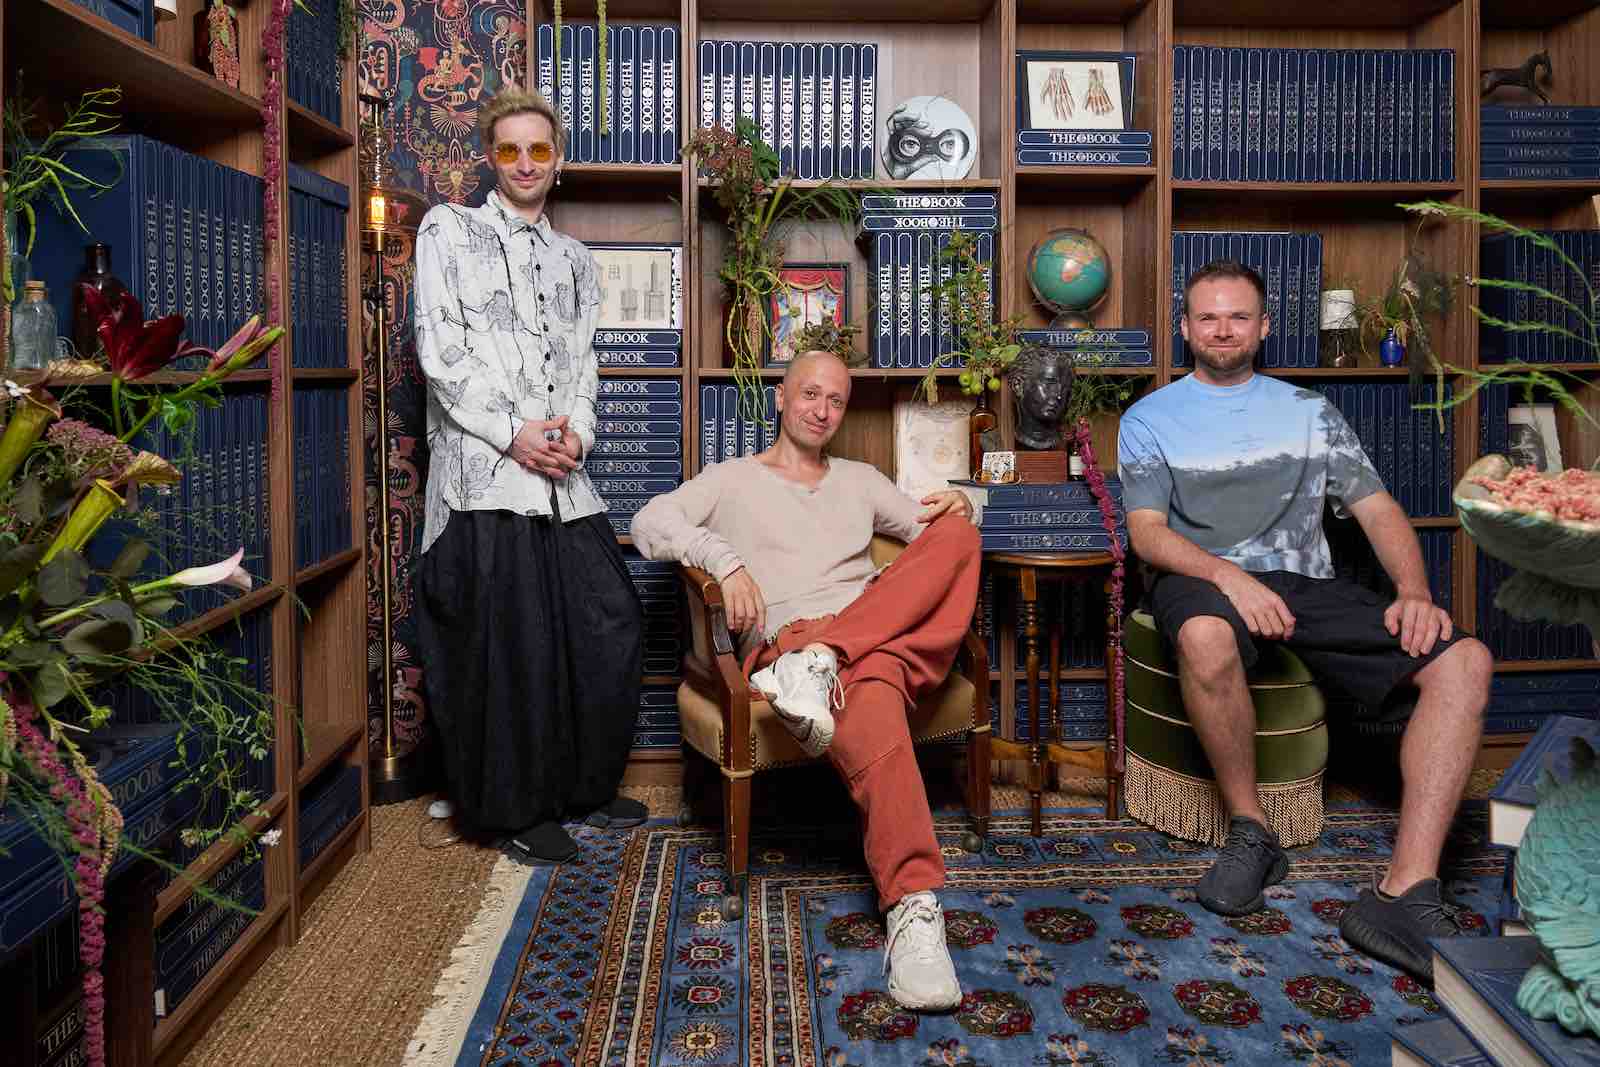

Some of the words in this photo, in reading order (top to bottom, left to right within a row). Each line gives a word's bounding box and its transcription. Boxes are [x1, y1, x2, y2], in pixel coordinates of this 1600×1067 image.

[541, 56, 552, 85] THE
[561, 58, 572, 86] THE
[581, 58, 592, 86] THE
[622, 59, 632, 87] THE
[642, 59, 653, 87] THE
[663, 60, 673, 88] THE
[702, 73, 714, 101] THE
[722, 74, 734, 102] THE
[742, 75, 754, 101] THE
[762, 75, 773, 102] THE
[782, 75, 793, 102] THE
[802, 75, 813, 102] THE
[822, 75, 833, 102] THE
[842, 76, 853, 103] THE
[862, 76, 873, 103] THE
[561, 97, 572, 131] BOOK
[581, 97, 592, 132] BOOK
[622, 97, 632, 132] BOOK
[642, 97, 653, 133] BOOK
[663, 97, 673, 133] BOOK
[702, 113, 714, 129] BO
[782, 114, 793, 149] BOOK
[802, 114, 813, 149] BOOK
[822, 114, 833, 149] BOOK
[842, 115, 853, 150] BOOK
[862, 115, 873, 150] BOOK
[1049, 133, 1077, 144] THE
[1087, 134, 1120, 144] BOOK
[1048, 151, 1076, 162] THE
[1087, 152, 1120, 162] BOOK
[895, 197, 921, 208] THE
[930, 197, 966, 208] BOOK
[146, 197, 159, 242] THE
[165, 200, 176, 244] THE
[183, 207, 193, 248] THE
[200, 208, 209, 253] THE
[894, 217, 929, 228] BOOK
[938, 217, 966, 228] THE
[215, 213, 225, 256] THE
[148, 256, 160, 318] BOOK
[166, 260, 176, 316] BOOK
[881, 264, 891, 291] THE
[901, 264, 911, 291] THE
[184, 263, 193, 321] BOOK
[200, 265, 209, 321] BOOK
[216, 269, 225, 321] BOOK
[231, 271, 240, 321] BOOK
[881, 302, 890, 336] BOOK
[901, 302, 910, 336] BOOK
[920, 302, 930, 336] BOOK
[613, 333, 648, 343] BOOK
[1047, 332, 1075, 344] THE
[610, 352, 646, 363] BOOK
[613, 382, 648, 393] BOOK
[615, 402, 649, 413] BOOK
[614, 422, 650, 433] BOOK
[704, 417, 714, 444] THE
[725, 418, 736, 445] THE
[612, 442, 648, 453] BOOK
[615, 462, 650, 473] BOOK
[611, 482, 647, 492] BOOK
[1010, 513, 1041, 524] THE
[1052, 513, 1088, 524] BOOK
[1011, 536, 1041, 547] THE
[1054, 536, 1091, 547] BOOK
[41, 1010, 79, 1057] THE
